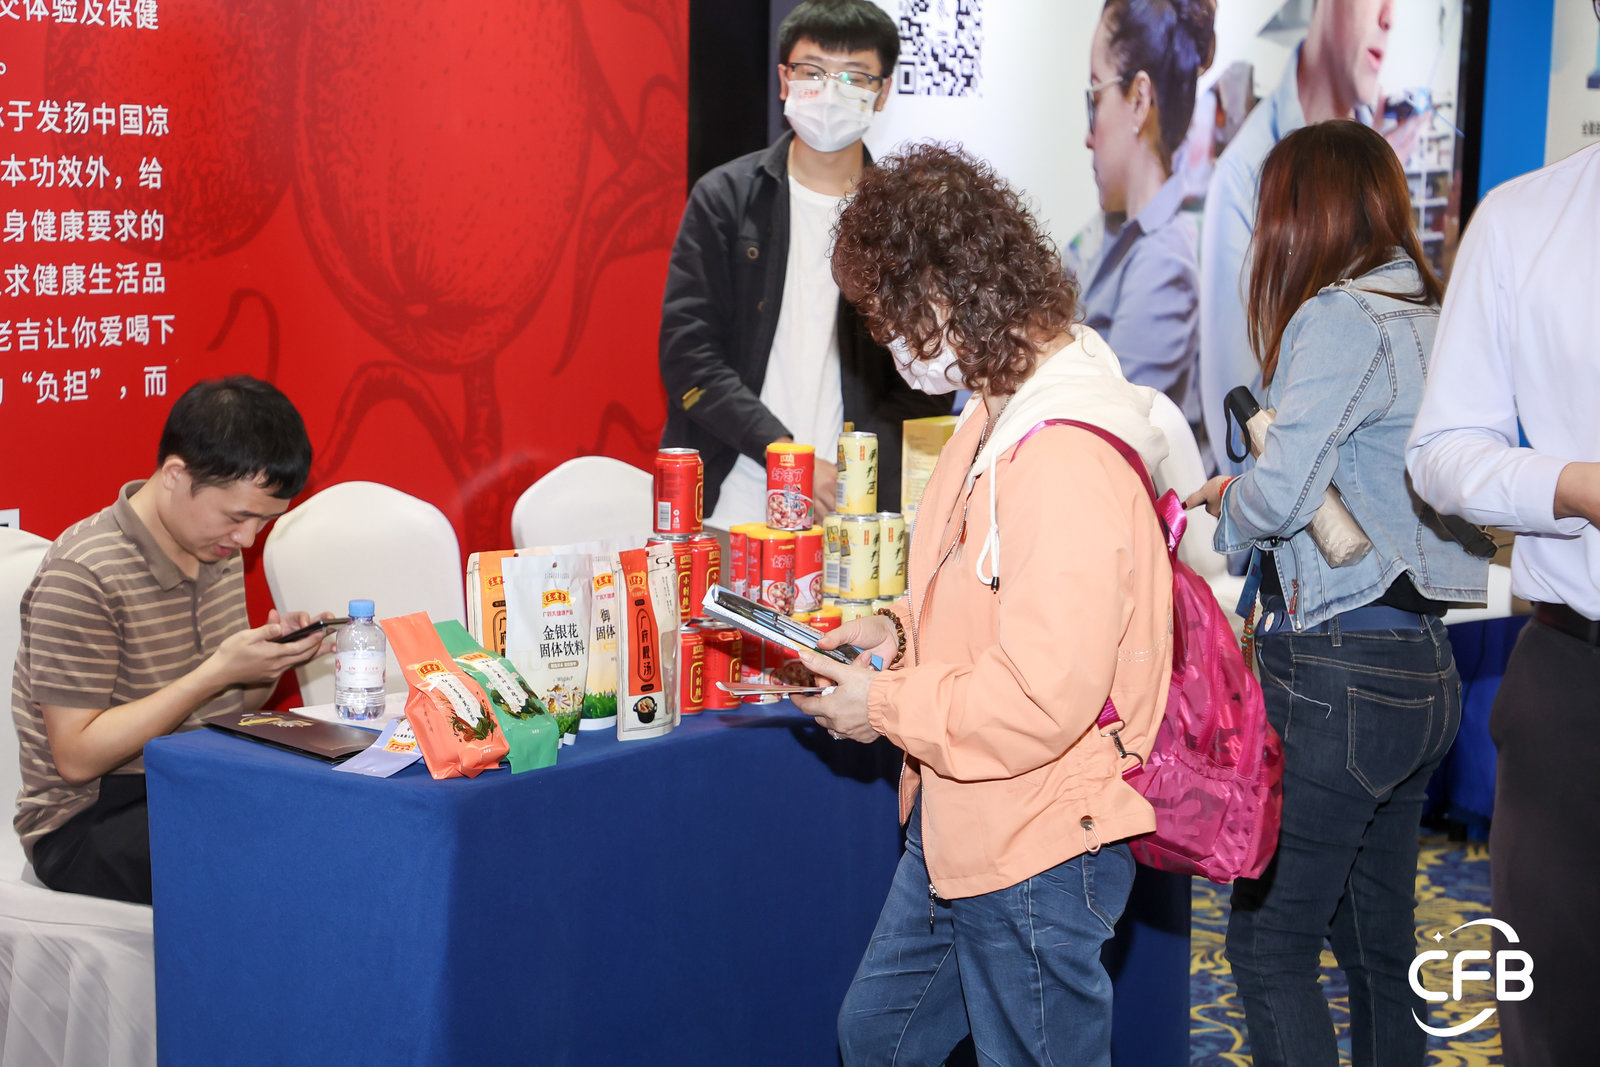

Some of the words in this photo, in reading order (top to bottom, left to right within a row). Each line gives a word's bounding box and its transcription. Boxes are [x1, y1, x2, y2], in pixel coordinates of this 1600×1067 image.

[0, 99, 169, 137] 于发扬中国凉
[0, 153, 163, 190] 本功效外，给
[3, 208, 164, 242] 身健康要求的
[0, 262, 166, 297] 求健康生活品
[0, 365, 167, 405] “负担”，而
[539, 639, 585, 659] 固体饮料
[542, 622, 579, 641] 金银花
